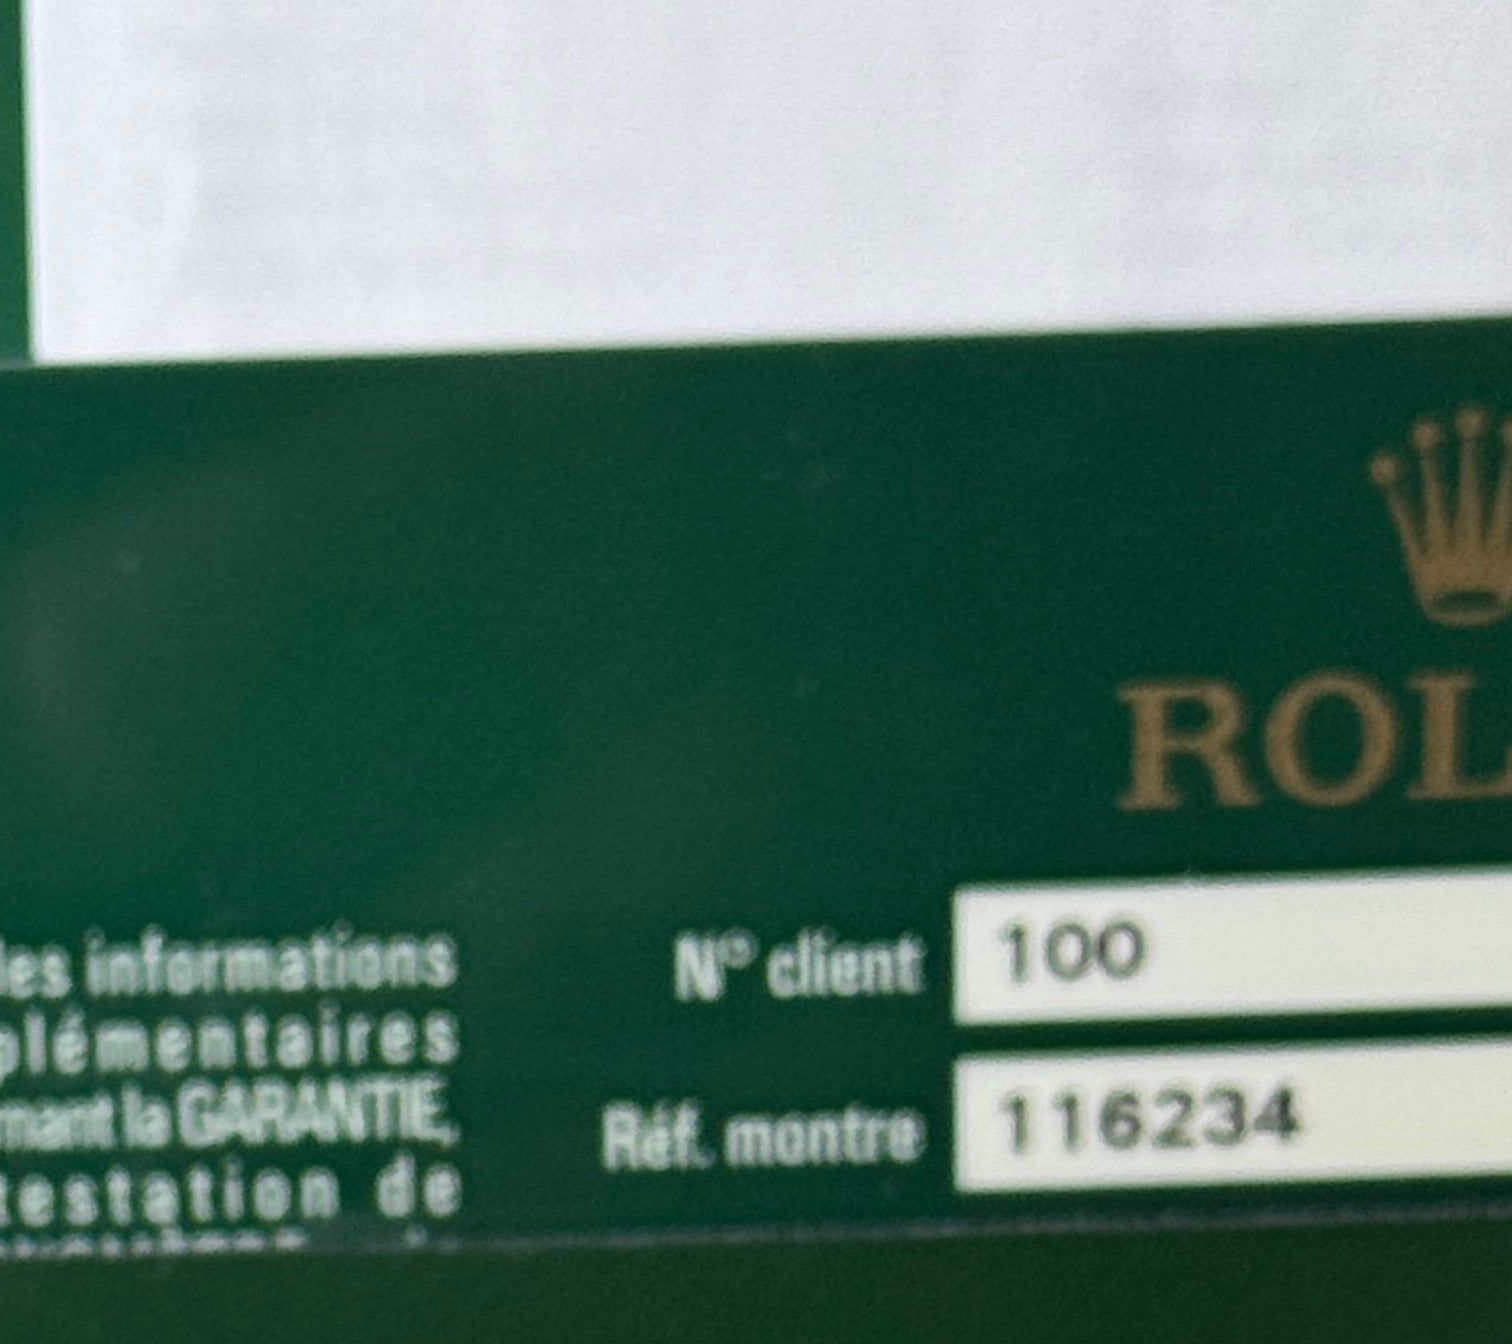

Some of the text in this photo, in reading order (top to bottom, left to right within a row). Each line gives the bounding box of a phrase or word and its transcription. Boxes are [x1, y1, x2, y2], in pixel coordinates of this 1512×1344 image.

[87, 924, 458, 995] informations
[674, 926, 928, 1002] N° client
[1003, 917, 1148, 983] 100
[123, 1084, 171, 1148] la
[601, 1101, 929, 1172] Réf. montre
[1005, 1085, 1301, 1155] 116234
[378, 1150, 462, 1219] de
